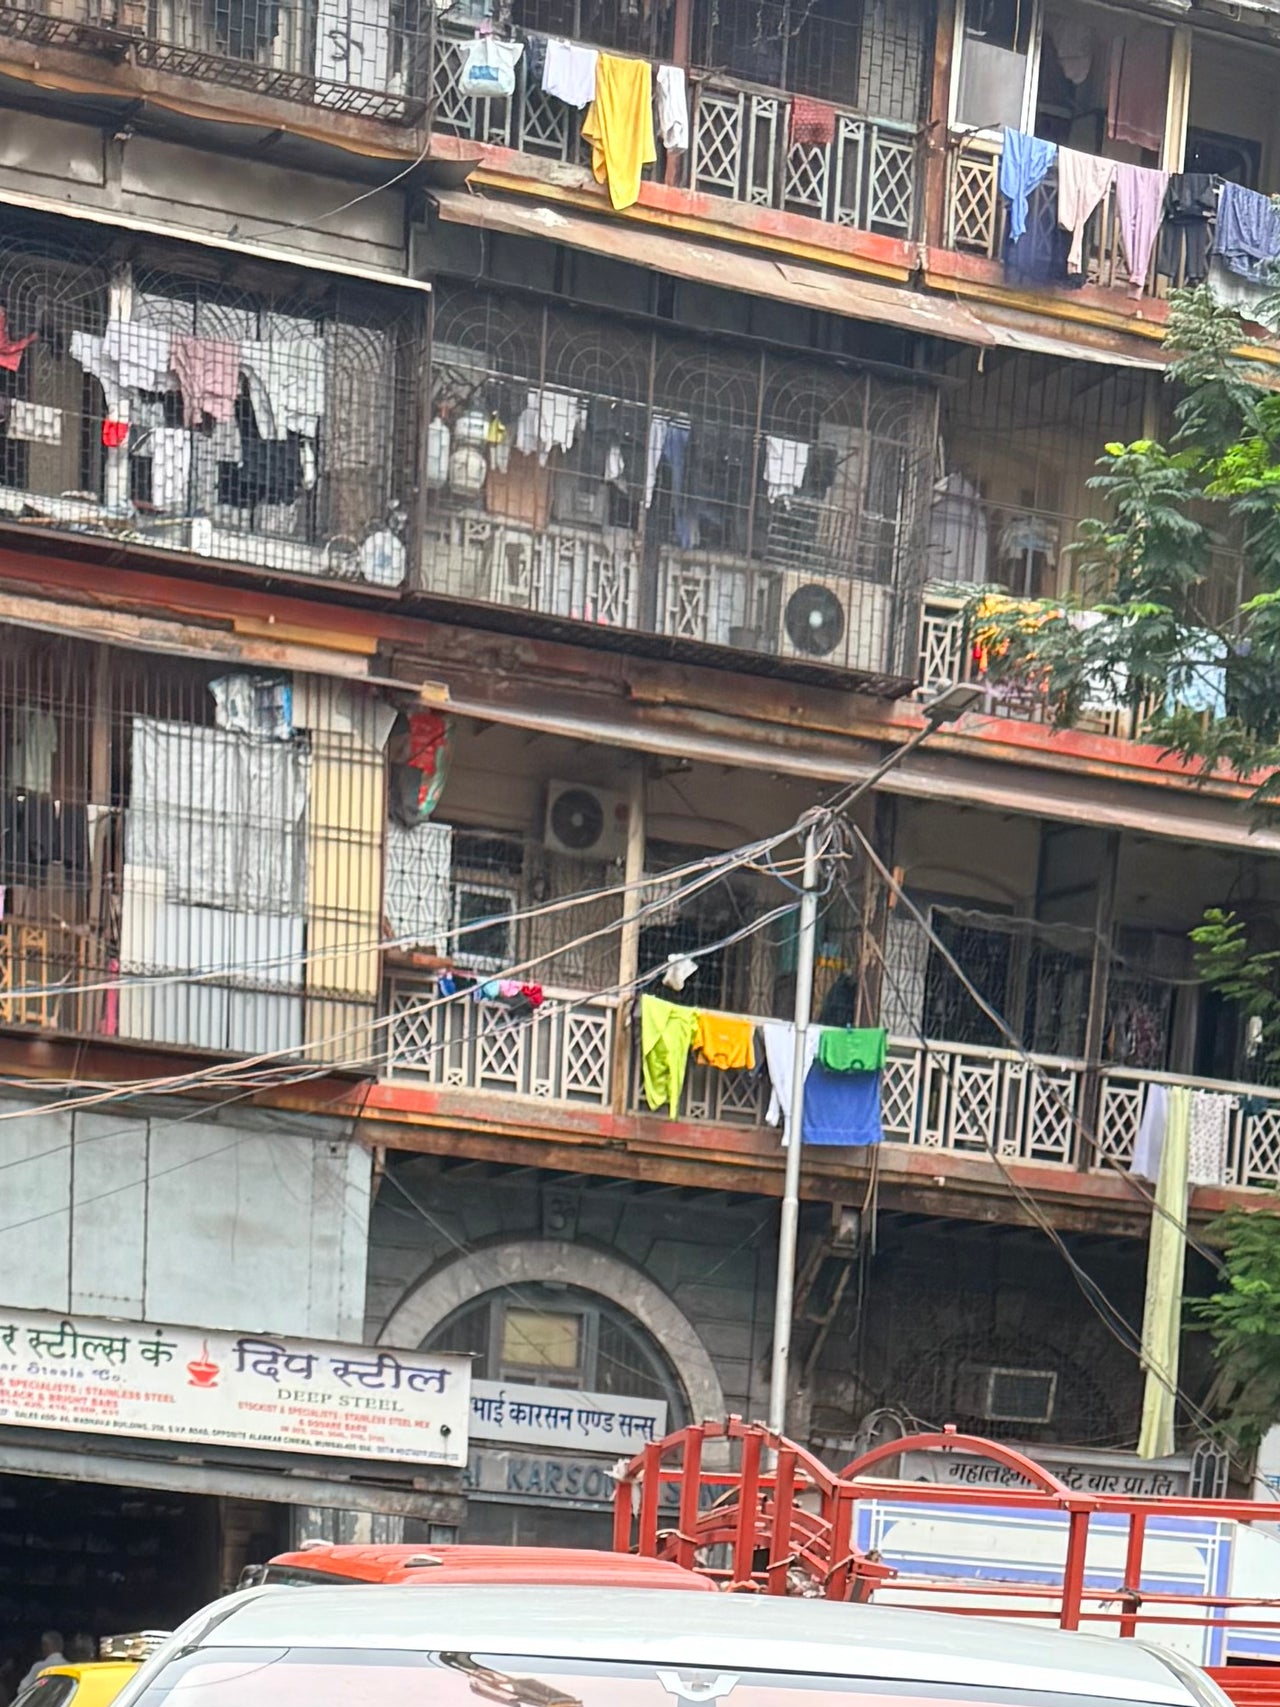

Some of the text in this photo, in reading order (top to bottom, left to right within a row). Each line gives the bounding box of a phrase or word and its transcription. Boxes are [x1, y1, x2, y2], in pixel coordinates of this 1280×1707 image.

[330, 1353, 452, 1394] स्टील
[277, 1388, 404, 1412] DEEP STEEL
[509, 1401, 574, 1430] कारसन
[577, 1407, 616, 1437] एण्ड
